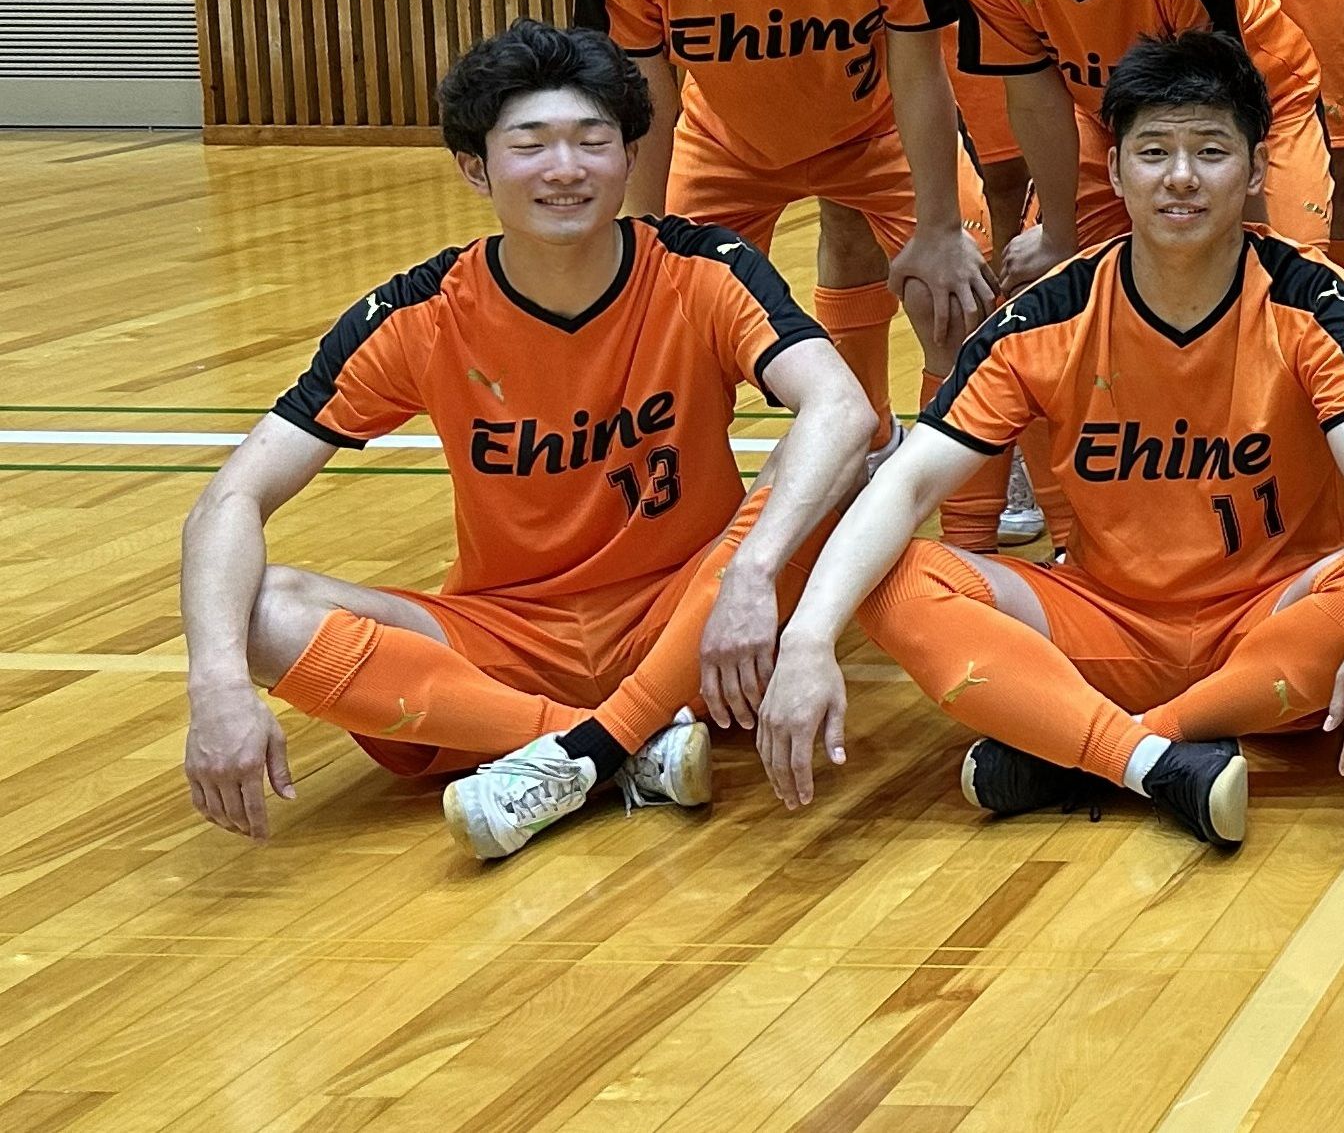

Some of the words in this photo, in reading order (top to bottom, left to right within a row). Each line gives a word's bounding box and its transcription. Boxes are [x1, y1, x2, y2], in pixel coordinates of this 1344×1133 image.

[670, 8, 888, 62] Ehime
[606, 444, 682, 528] 13
[1074, 418, 1272, 482] Ehime
[1210, 476, 1286, 558] 11
